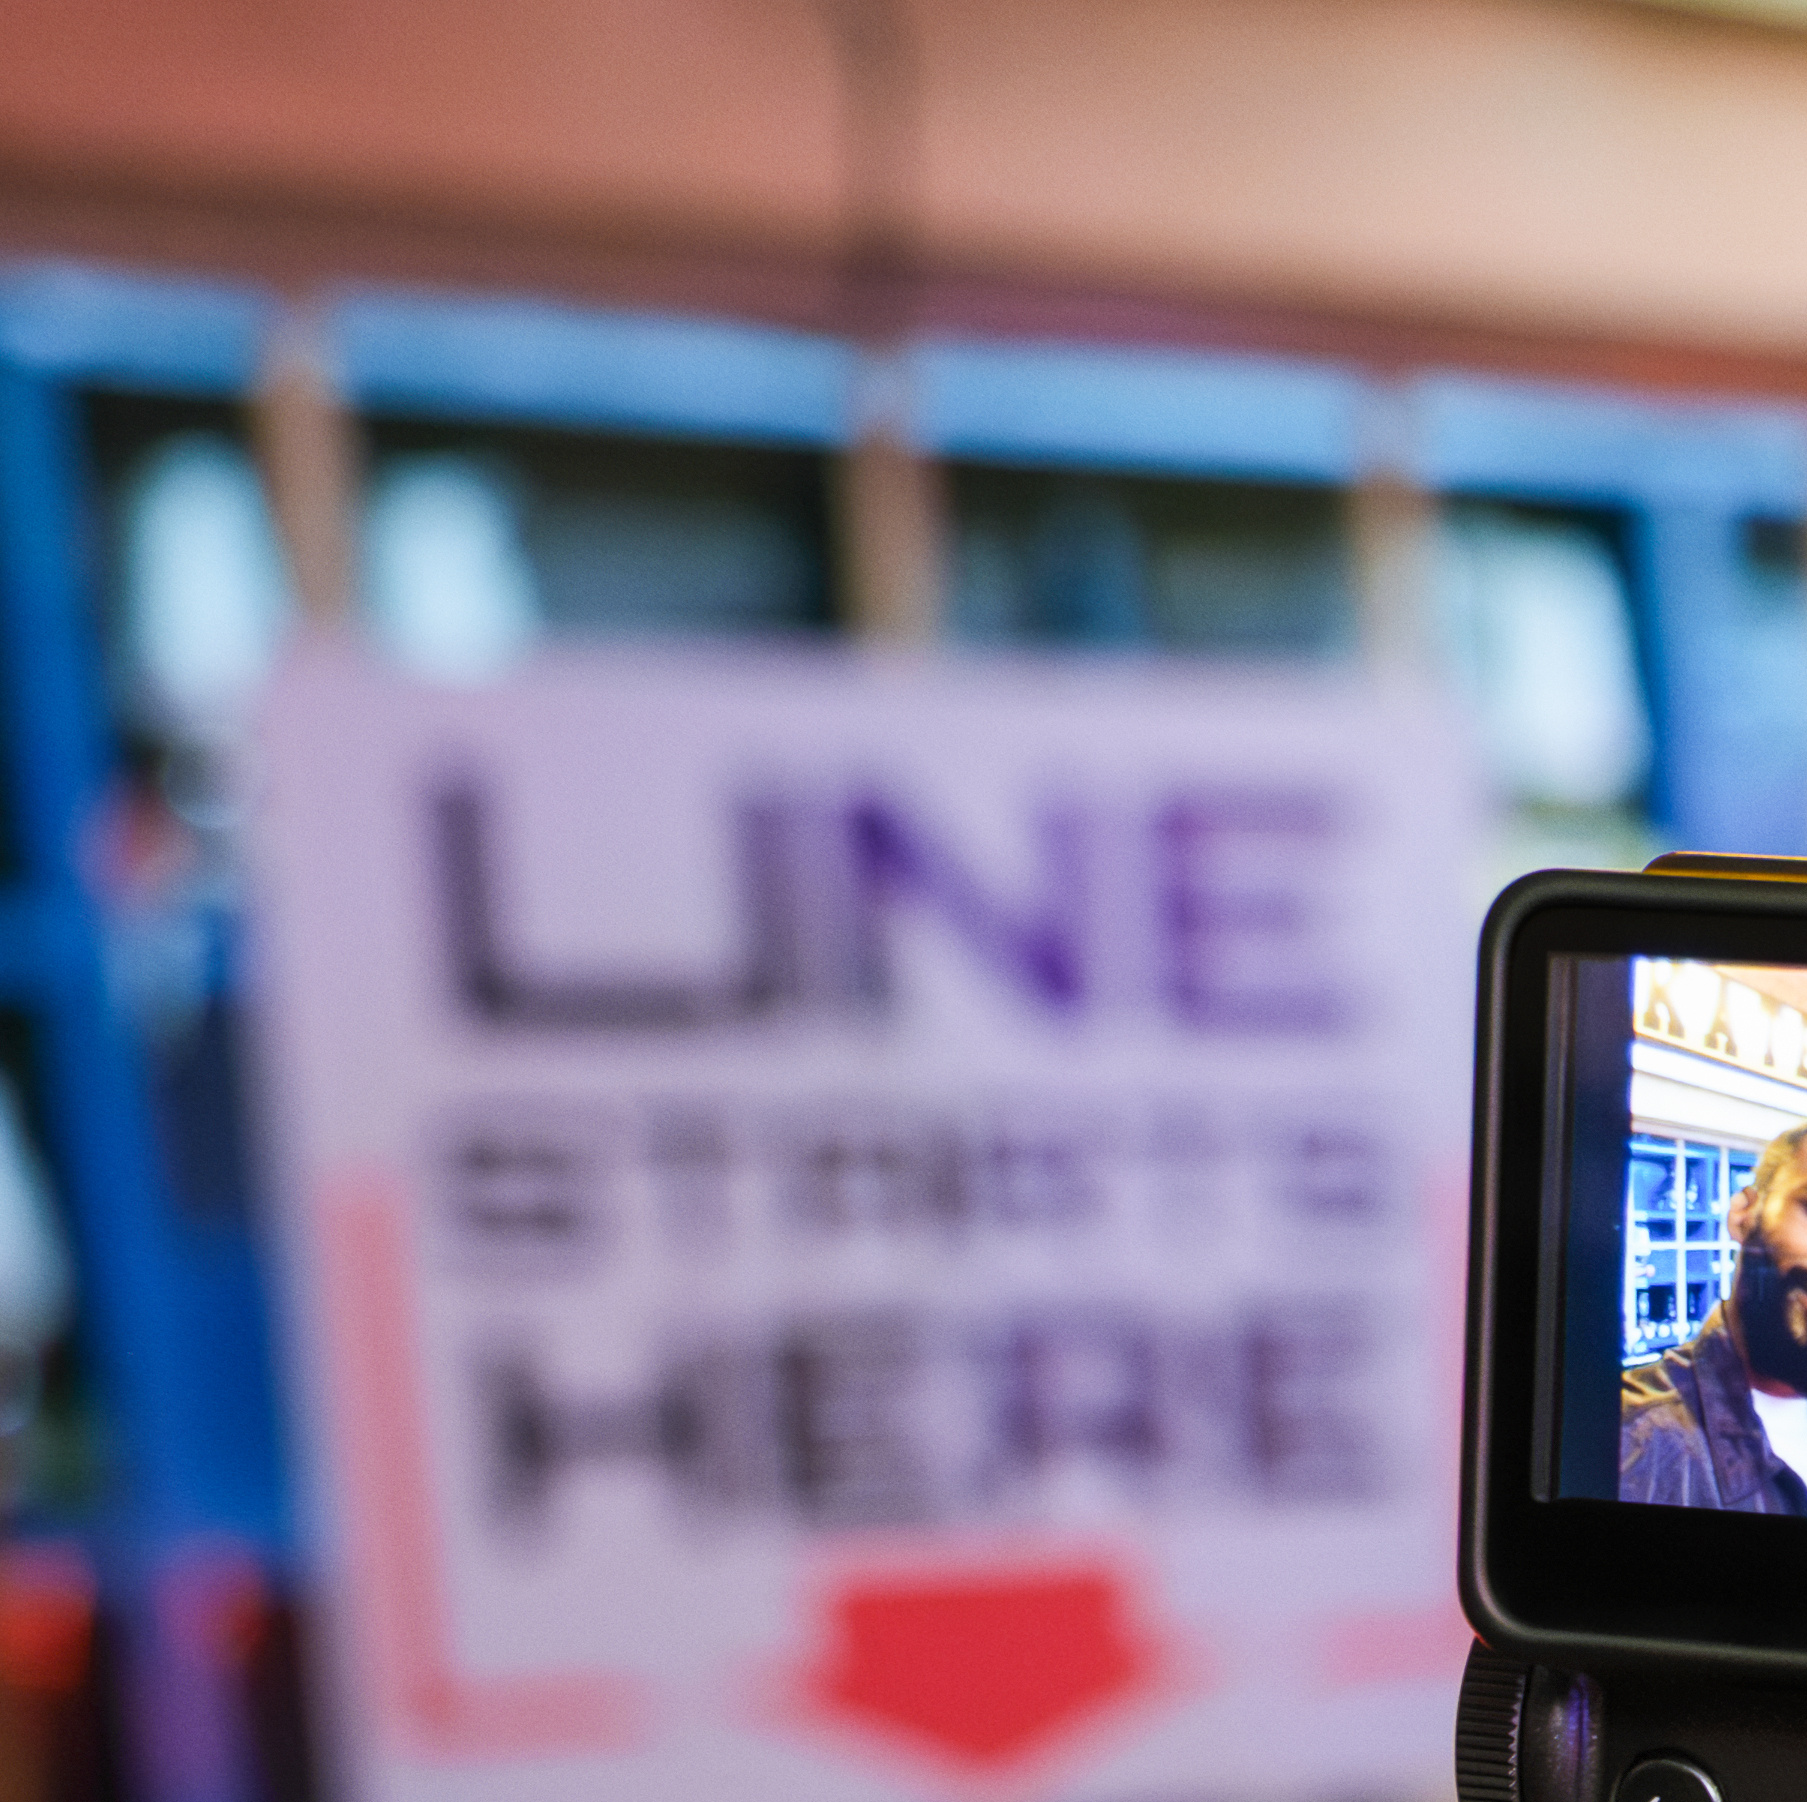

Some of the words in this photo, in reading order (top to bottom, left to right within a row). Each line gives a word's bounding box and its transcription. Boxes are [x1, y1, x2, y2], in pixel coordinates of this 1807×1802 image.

[425, 750, 1352, 1035] LINE
[440, 1095, 1392, 1268] STARTS
[475, 1300, 1390, 1545] HERE
